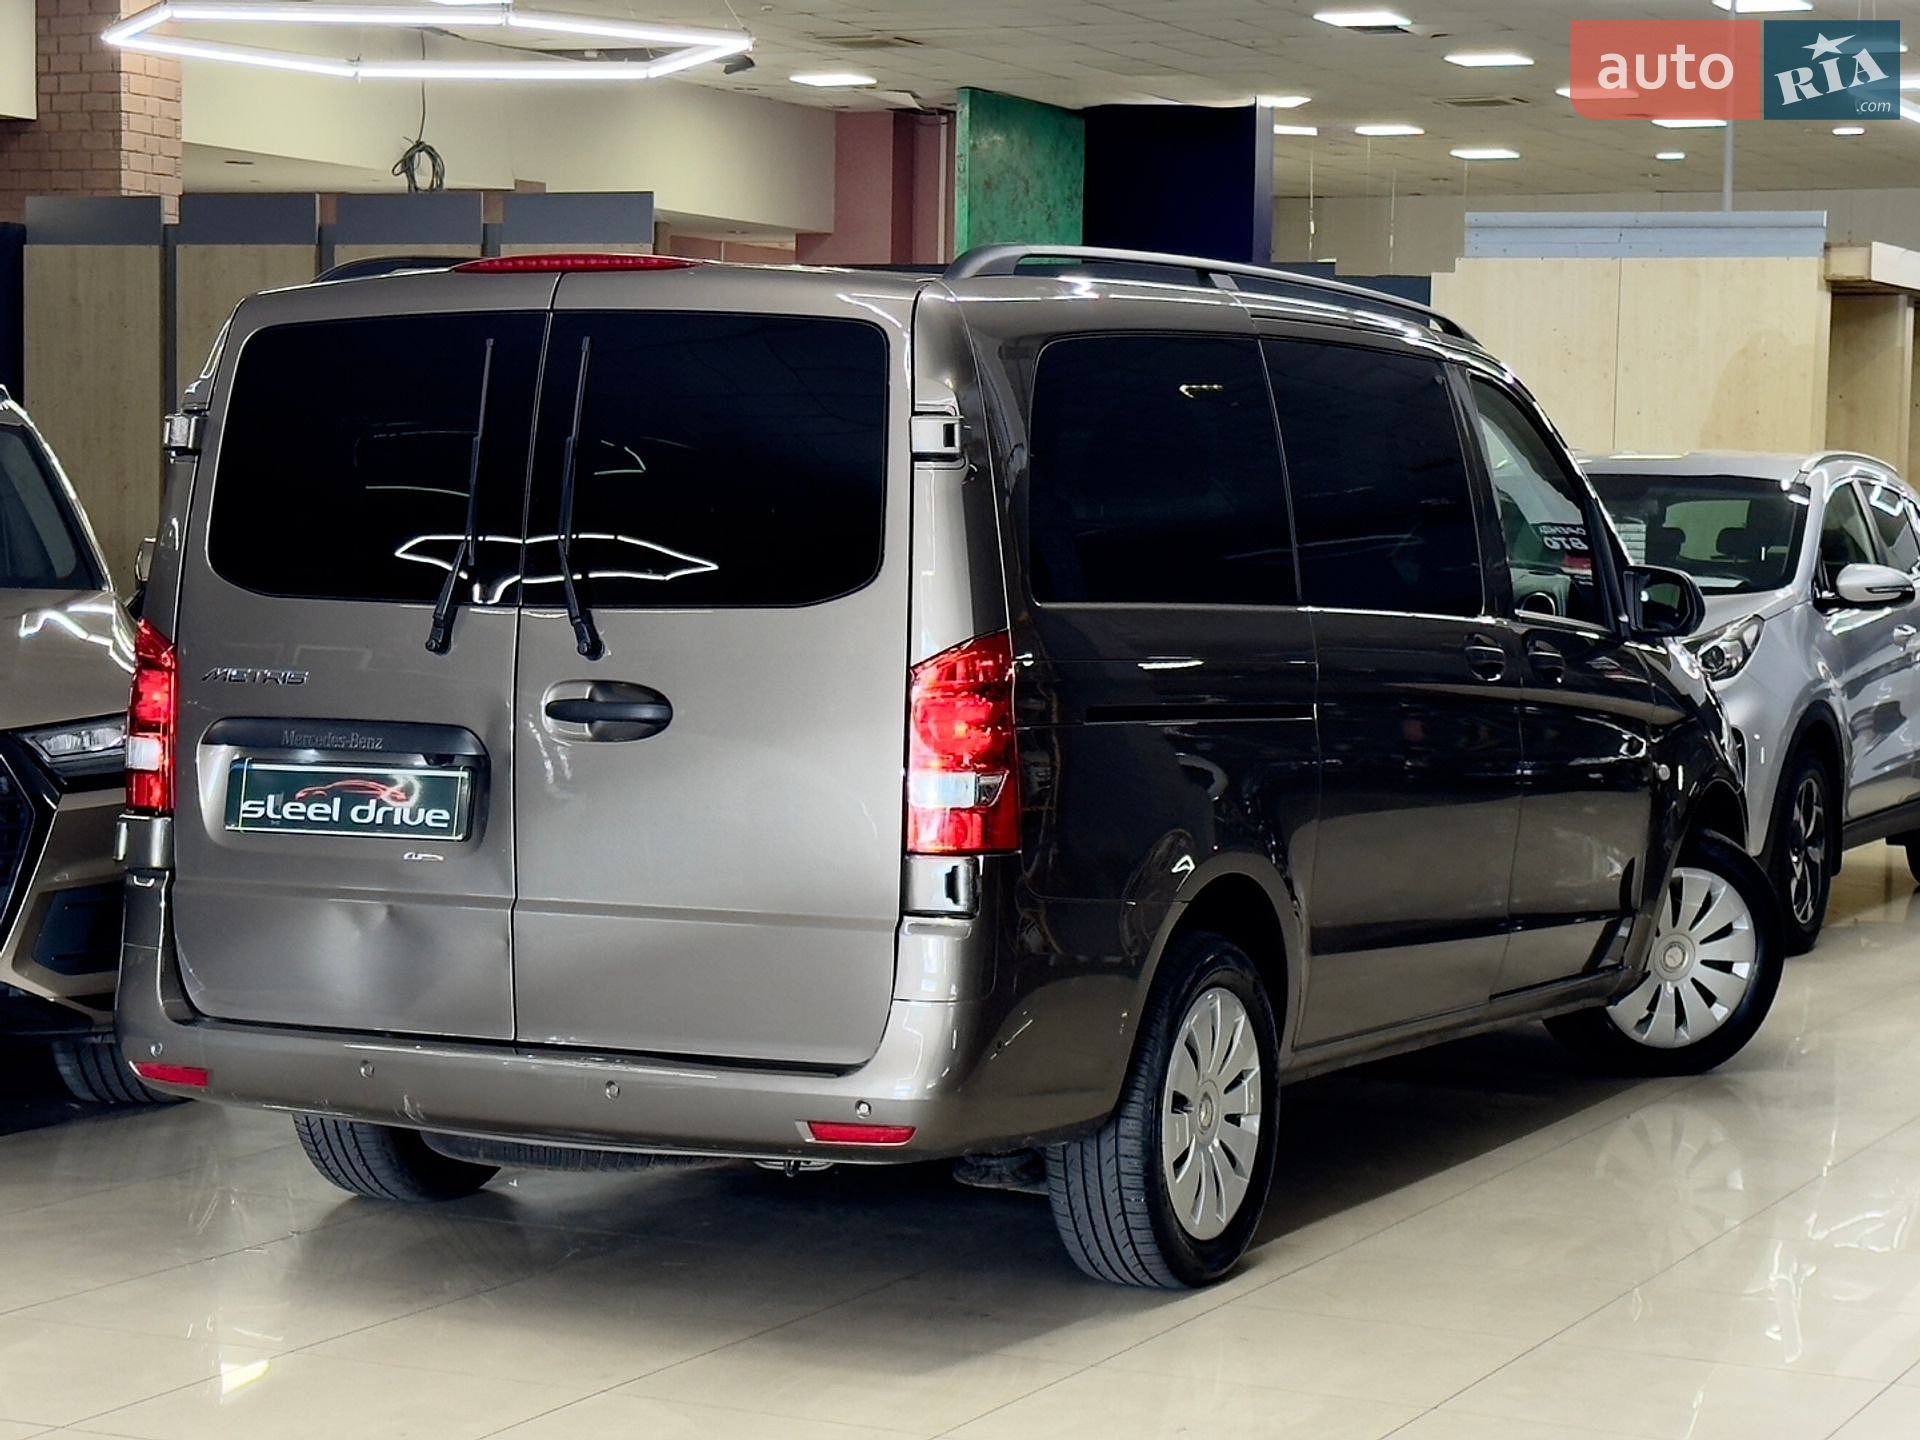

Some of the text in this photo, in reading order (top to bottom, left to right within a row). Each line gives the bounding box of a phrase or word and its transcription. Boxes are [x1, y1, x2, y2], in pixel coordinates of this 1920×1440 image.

[201, 667, 309, 685] METRIS
[282, 728, 384, 749] Mercedes-Benz
[241, 794, 450, 828] steel drive
